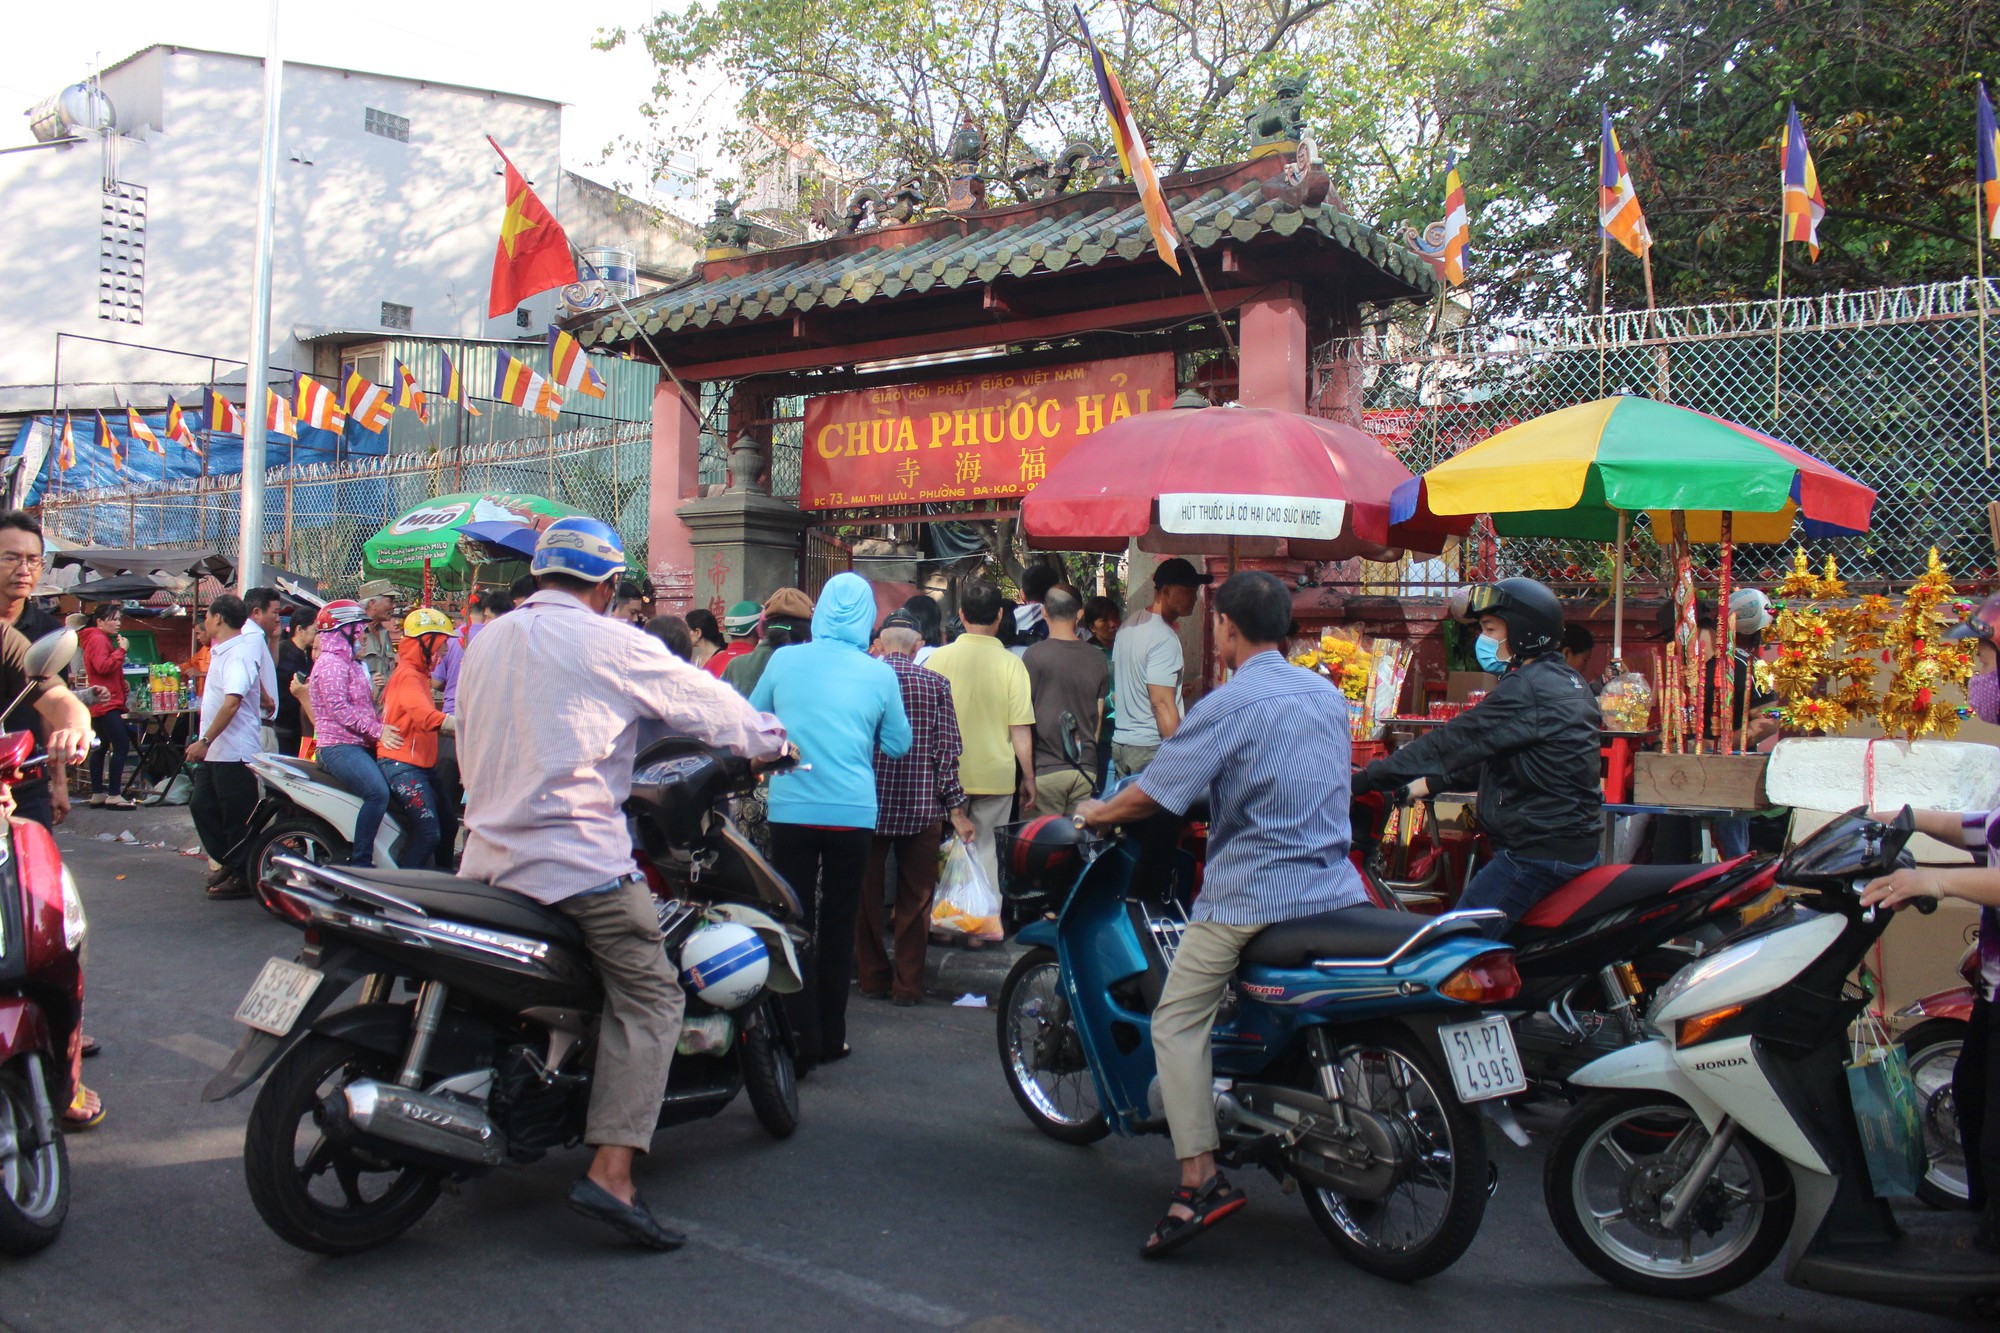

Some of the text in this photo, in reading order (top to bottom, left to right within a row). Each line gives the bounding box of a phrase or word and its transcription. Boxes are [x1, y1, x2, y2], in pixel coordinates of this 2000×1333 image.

[872, 368, 1085, 404] GIÁO HỘI PHẬT GIÁO VIỆT NAM
[817, 372, 1152, 459] CHÙA PHƯỚC HẢI
[850, 495, 866, 504] MAI
[869, 494, 883, 505] THỊ
[888, 490, 907, 504] LỰU
[919, 483, 966, 499] PHƯỜNG
[399, 513, 457, 526] MILO
[1181, 499, 1321, 526] HÚT THUỐC LÁ CÓ HẠI CHO SỨC KHỎE
[431, 542, 448, 550] MILO
[1466, 1056, 1515, 1092] 4996
[1695, 1057, 1749, 1070] HONDA
